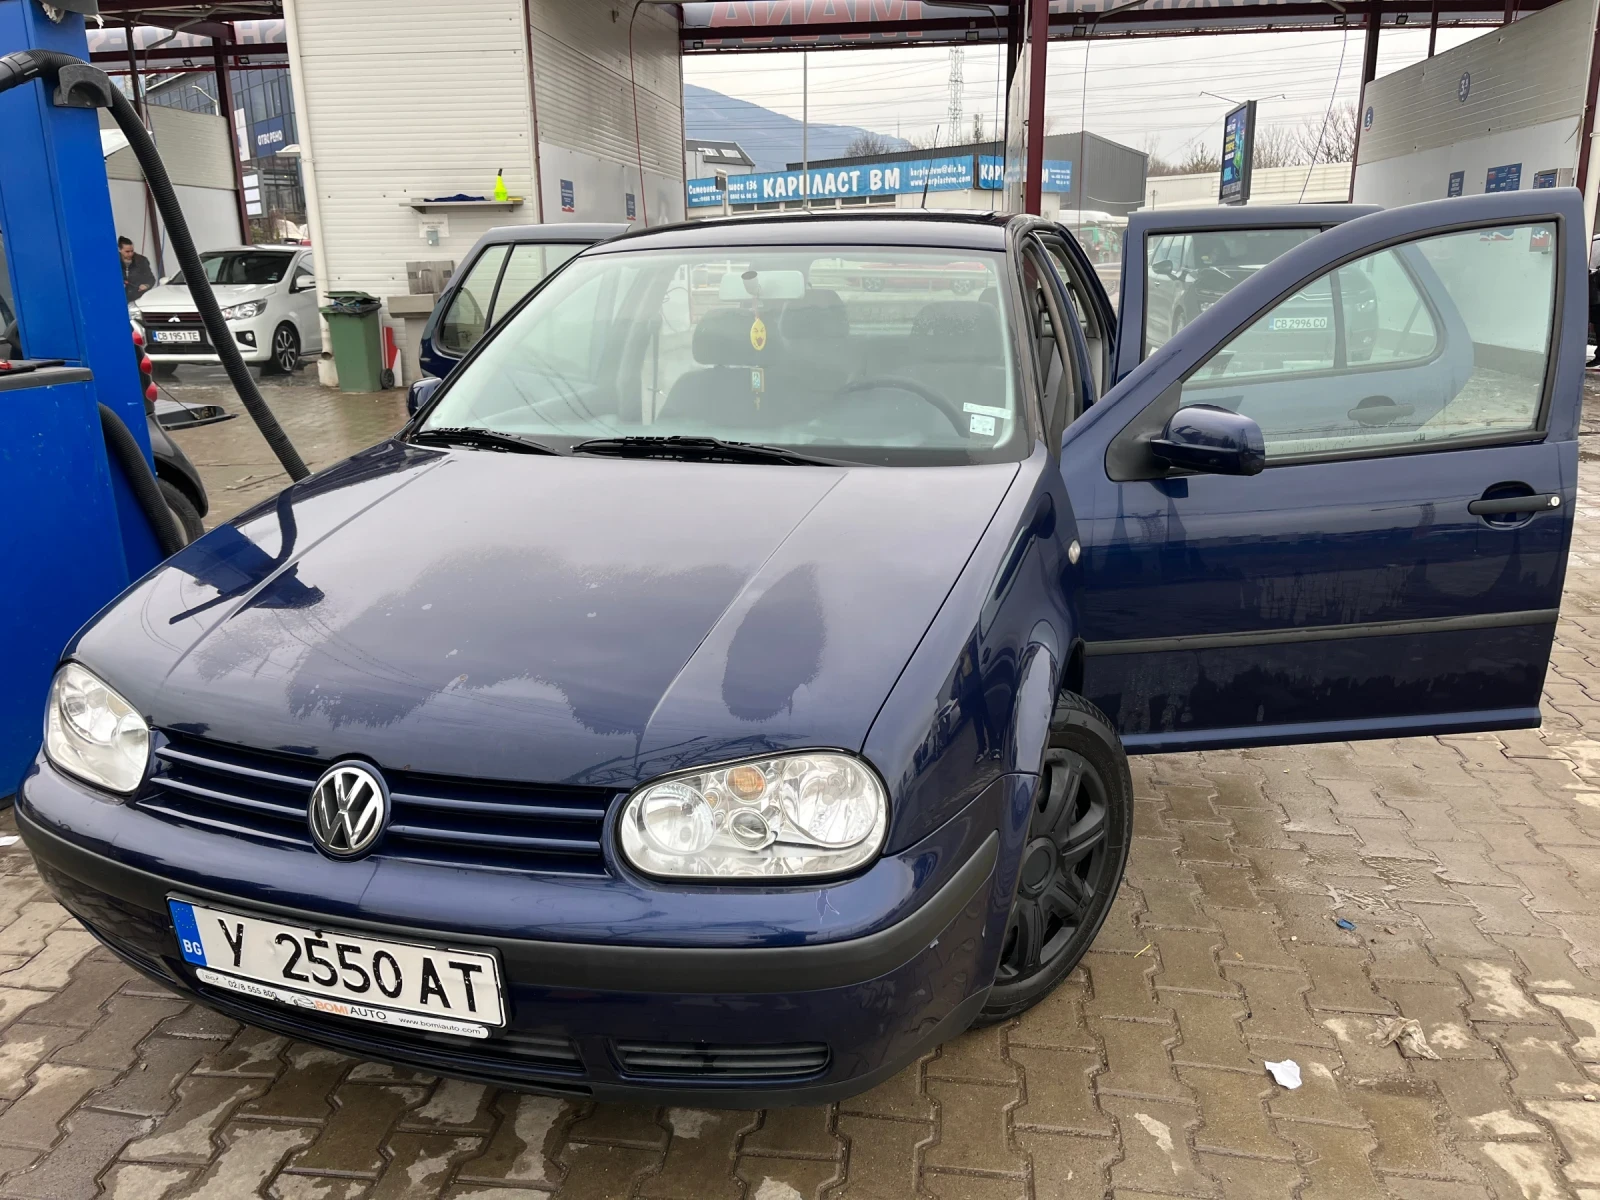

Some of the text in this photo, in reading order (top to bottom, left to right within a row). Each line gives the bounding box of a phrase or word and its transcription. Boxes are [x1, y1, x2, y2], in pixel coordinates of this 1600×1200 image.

[746, 180, 757, 190] 136
[763, 167, 900, 198] КАРПЛАСТ ВМ
[1275, 318, 1326, 329] CB 2996 CO
[157, 332, 168, 341] CB
[169, 332, 187, 341] 1951
[187, 332, 199, 341] TE
[311, 766, 384, 855] VW
[183, 939, 203, 956] BG
[217, 918, 483, 1014] Y 2550 AT
[247, 985, 261, 995] 555
[262, 989, 277, 999] 800
[315, 1000, 387, 1021] BOMI AUTO
[398, 1017, 481, 1036] www.bomiauto.com
